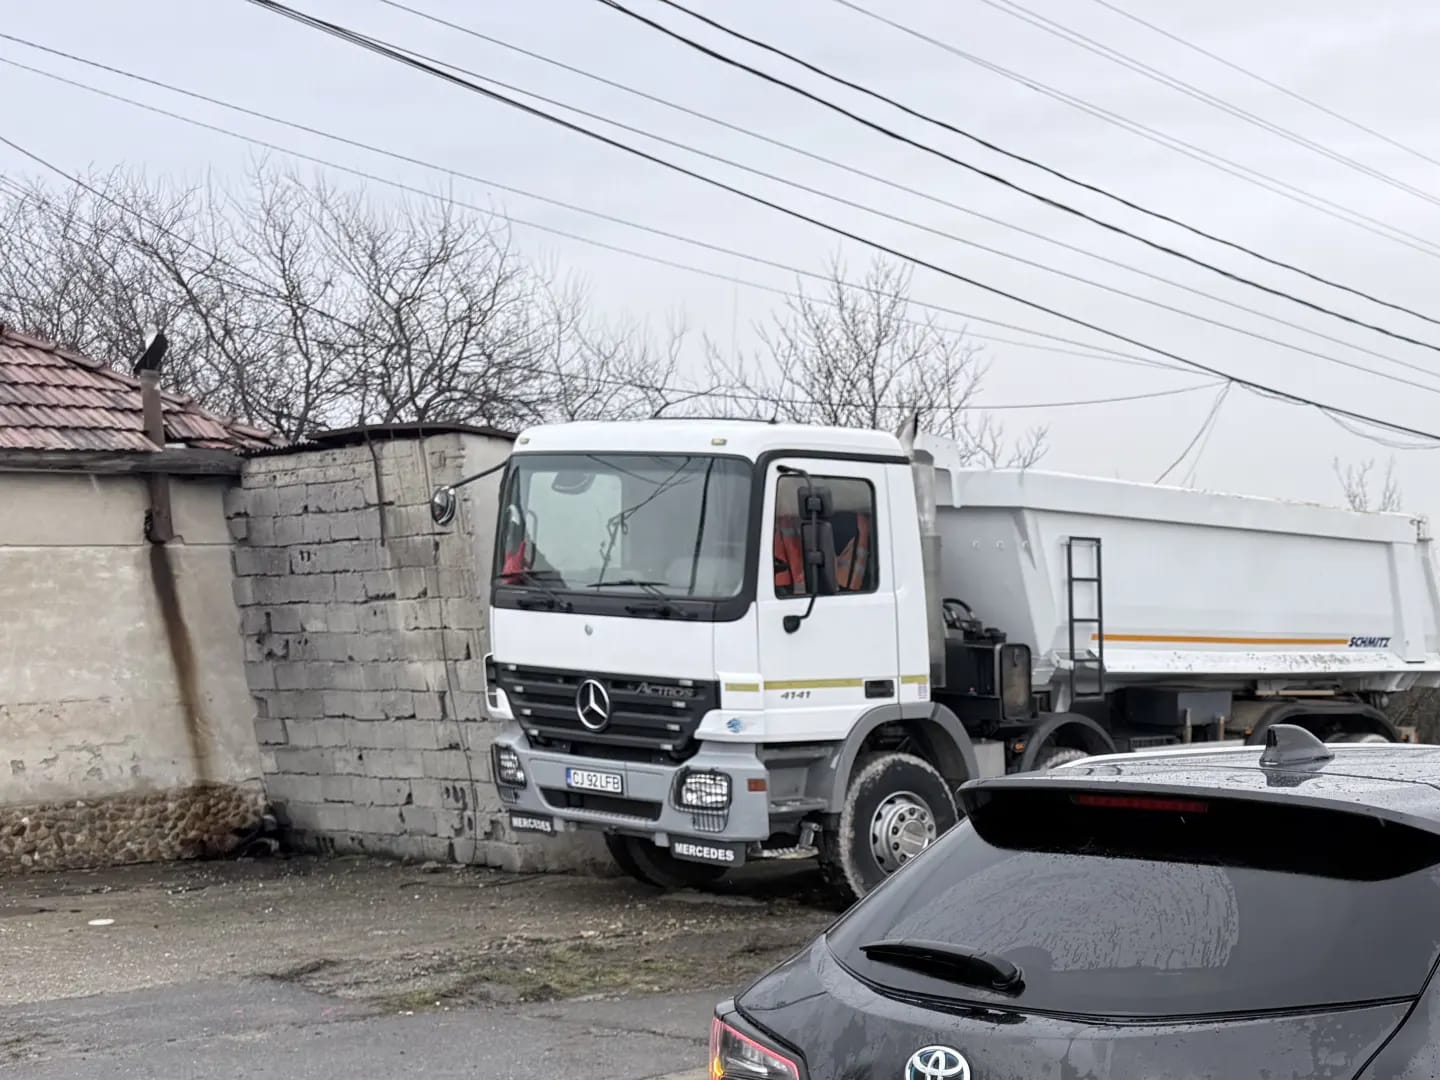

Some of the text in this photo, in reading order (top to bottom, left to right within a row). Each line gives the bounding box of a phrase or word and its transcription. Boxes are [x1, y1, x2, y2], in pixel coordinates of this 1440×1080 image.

[1348, 636, 1391, 648] SCHMITZ
[780, 690, 811, 700] 4141
[573, 771, 585, 785] CJ
[675, 842, 735, 861] MERCEDES
